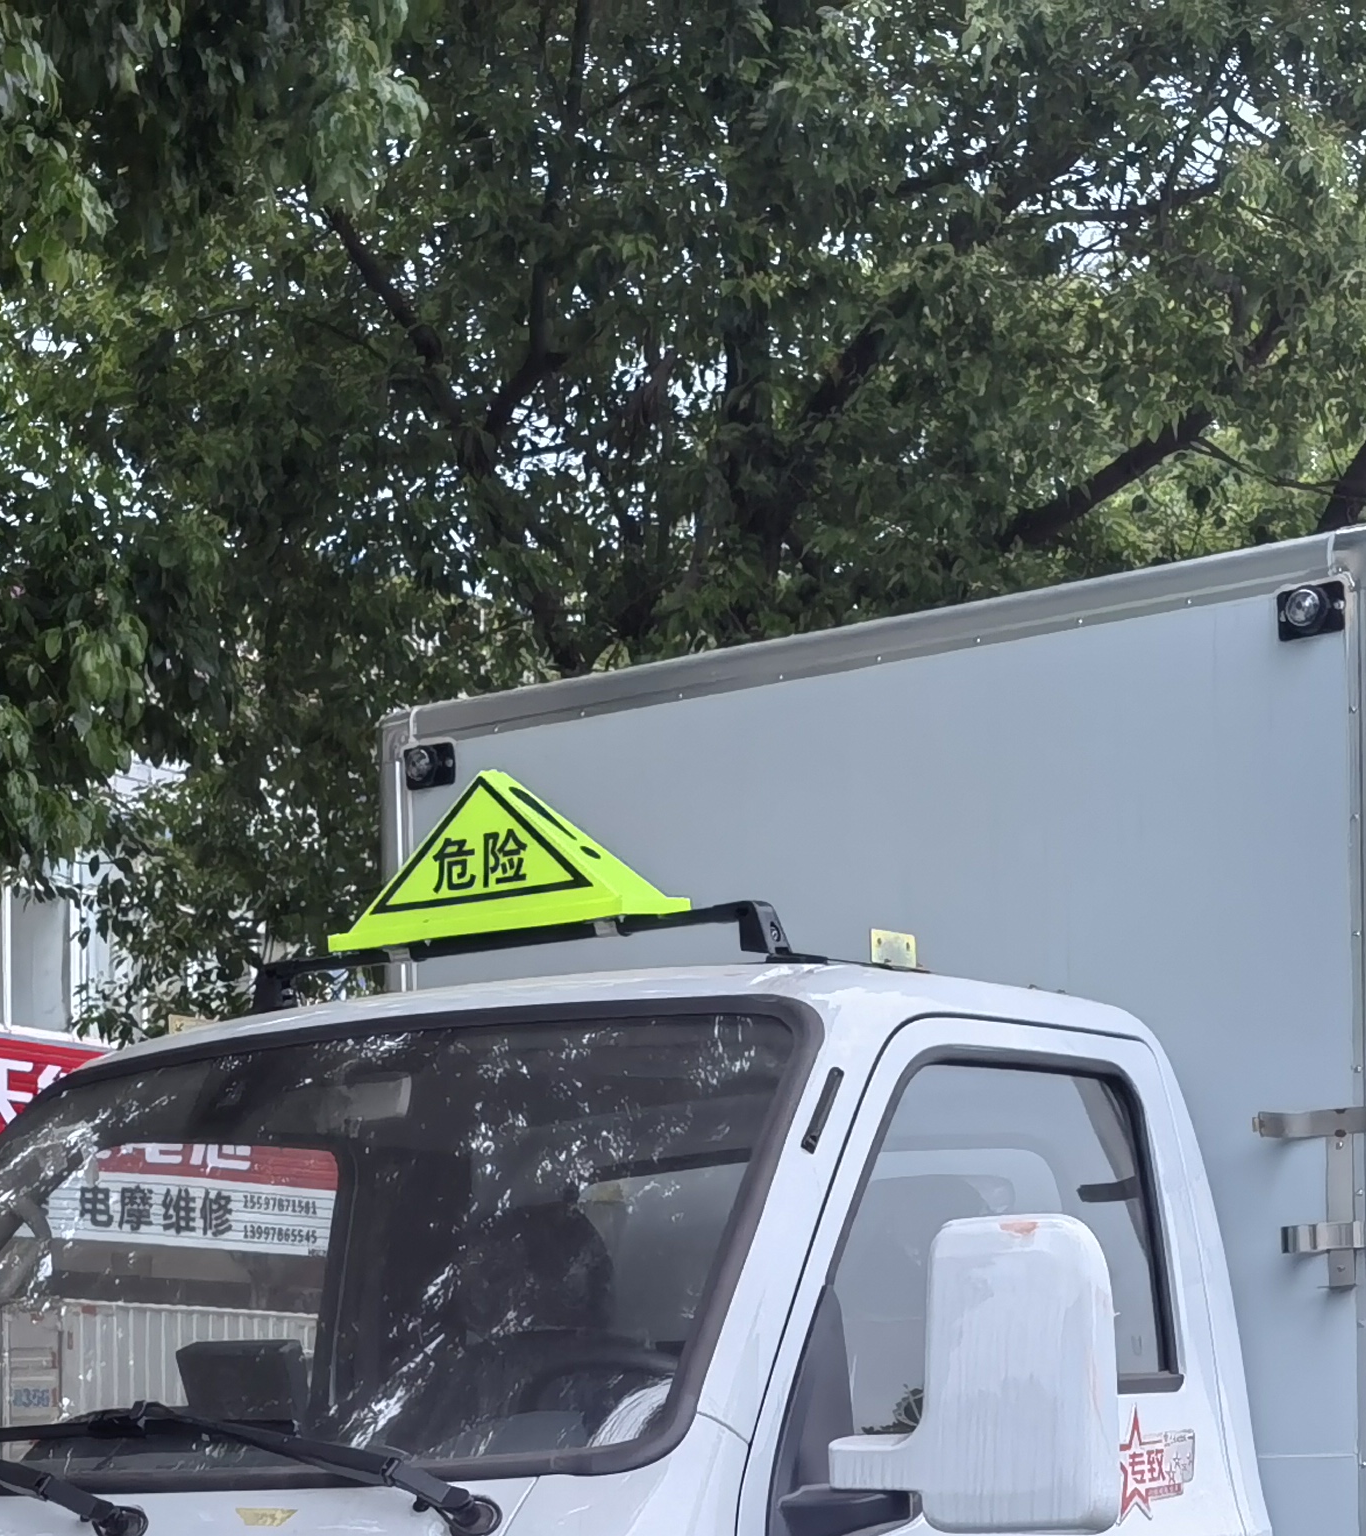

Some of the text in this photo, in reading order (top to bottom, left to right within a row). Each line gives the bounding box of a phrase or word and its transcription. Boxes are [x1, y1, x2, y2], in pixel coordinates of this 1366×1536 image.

[431, 828, 528, 894] 危险
[79, 1185, 233, 1237] 电摩维修
